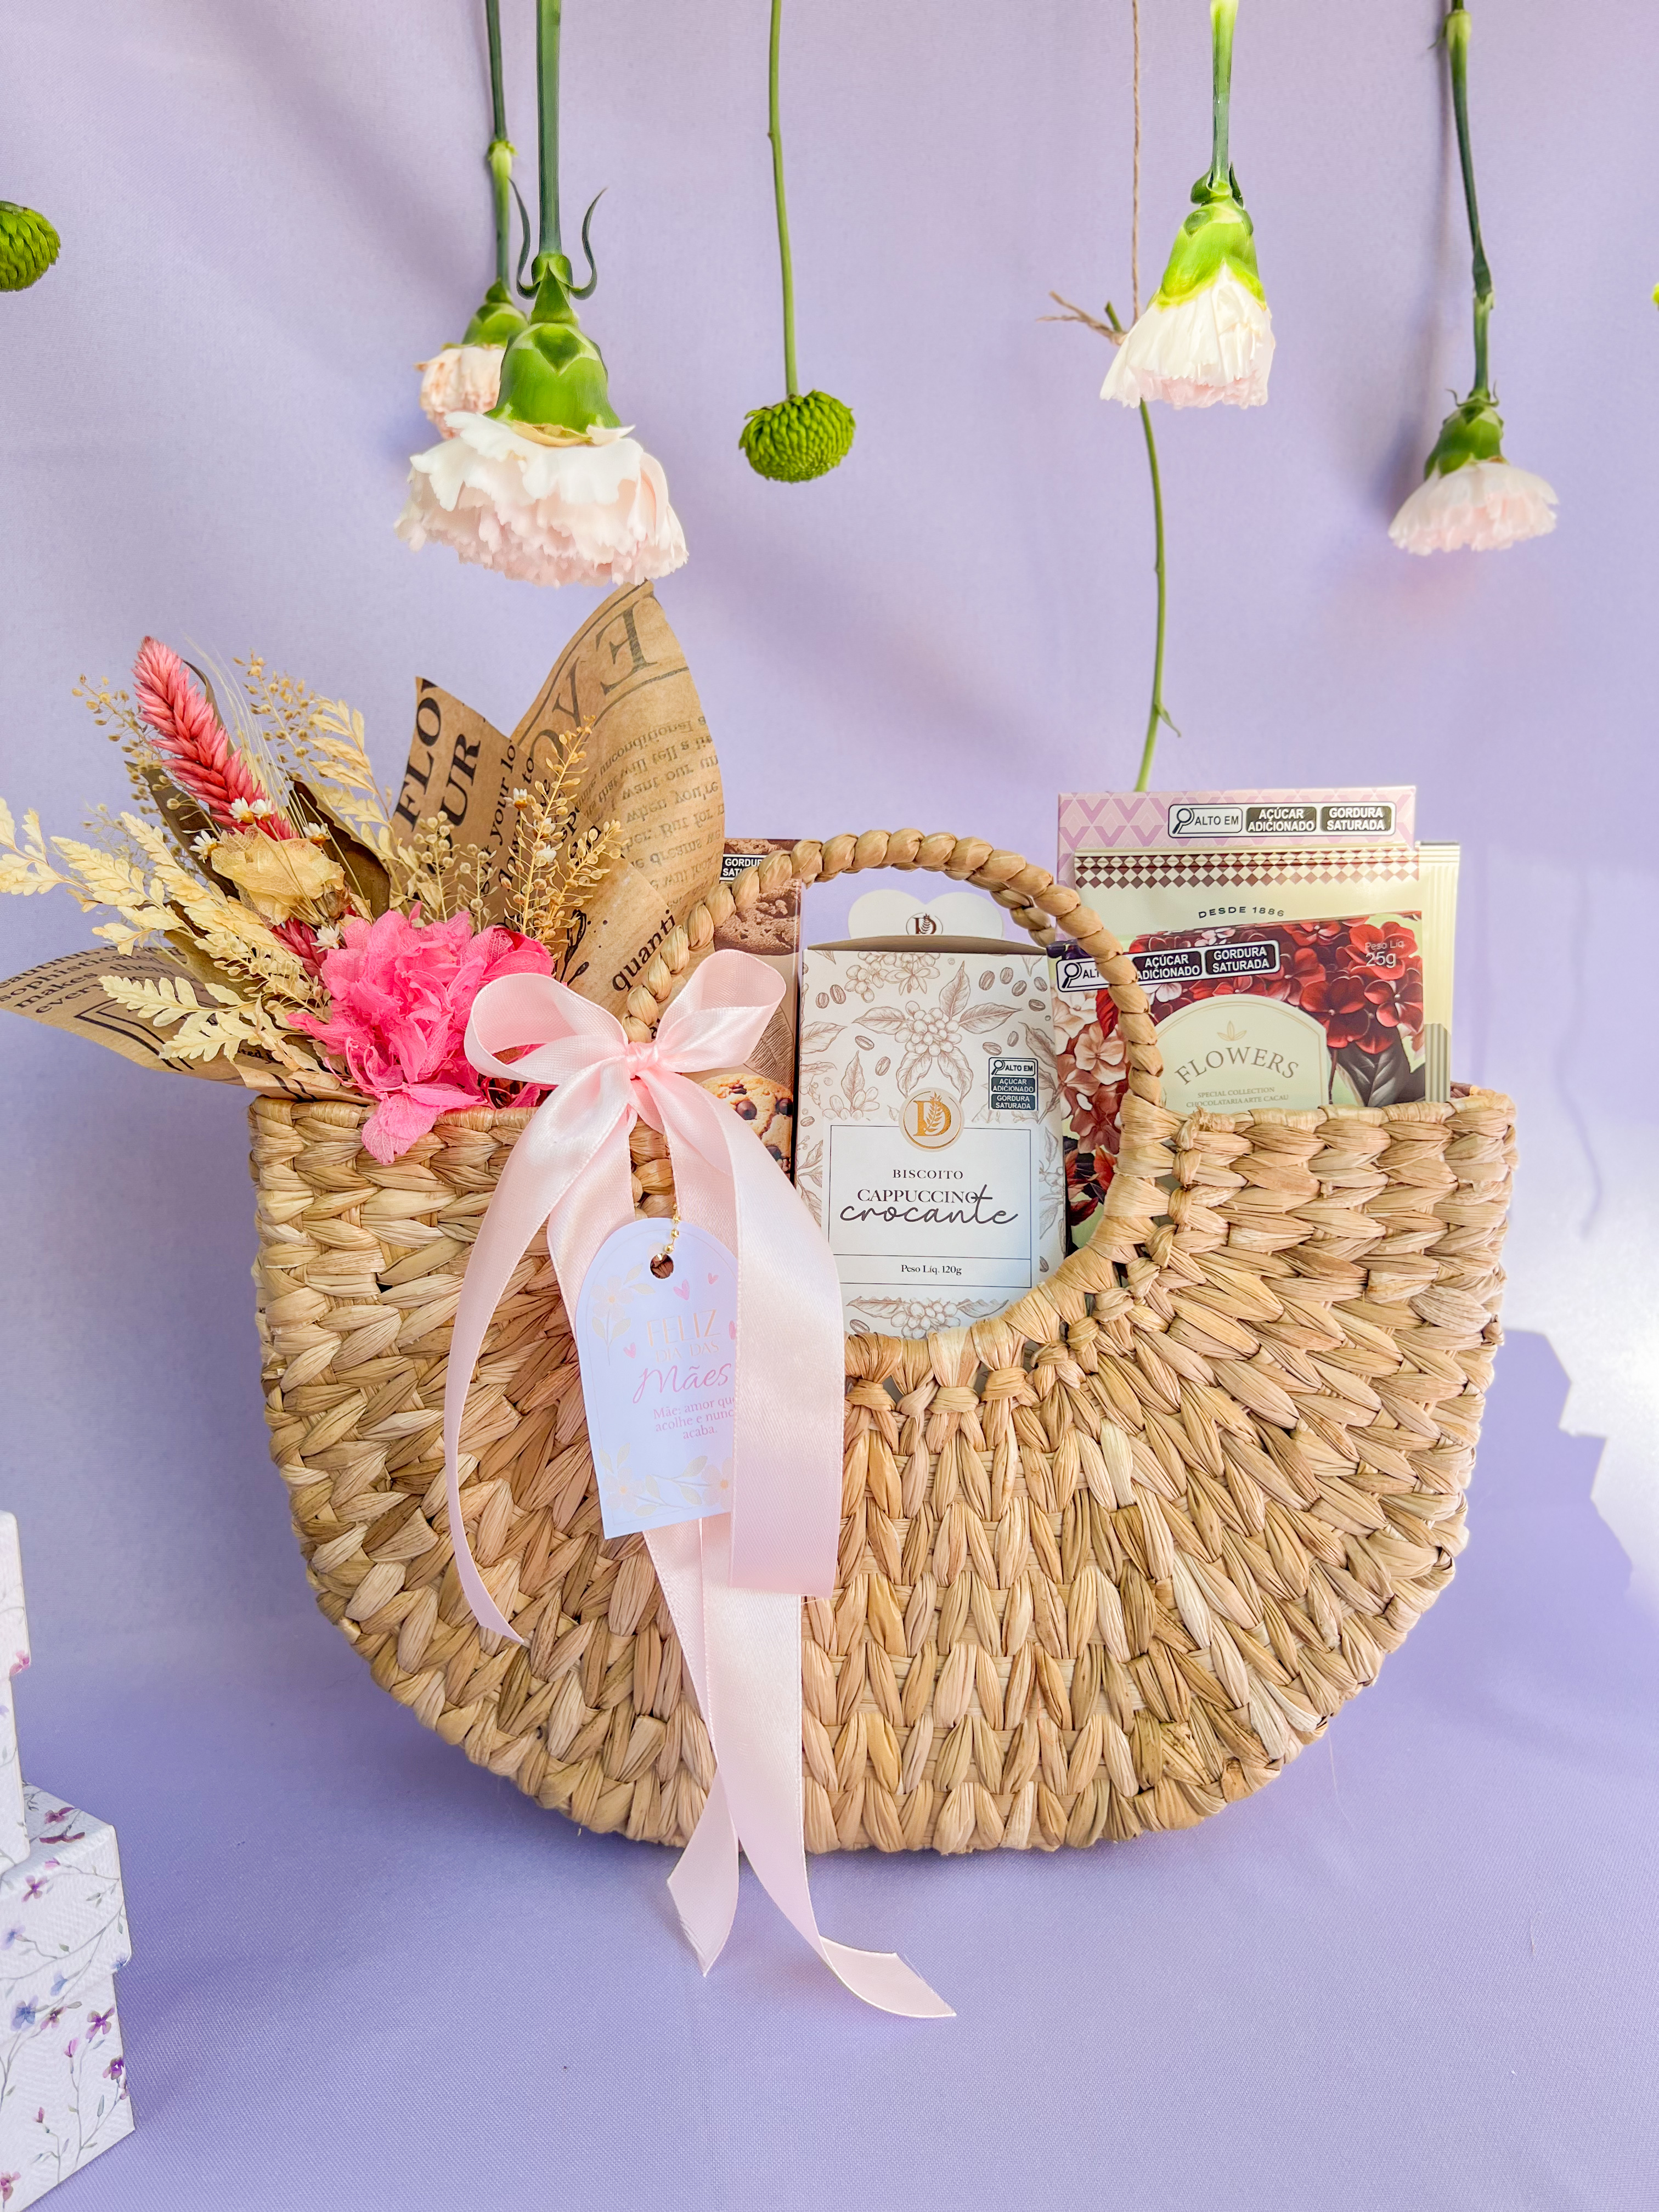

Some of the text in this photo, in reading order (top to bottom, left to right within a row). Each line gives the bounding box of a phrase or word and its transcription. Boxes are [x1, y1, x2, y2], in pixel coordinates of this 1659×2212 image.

[490, 777, 509, 846] your
[1259, 807, 1304, 821] AÇÚCAR
[1329, 807, 1384, 819] GORDURA
[1194, 815, 1239, 826] ALTO EM
[1247, 820, 1315, 832] ADICIONADO
[1327, 819, 1385, 831] SATURADA
[1199, 906, 1284, 919] DESDE 1886
[1214, 946, 1267, 961] GORDURA
[1365, 951, 1396, 968] 25g
[1144, 954, 1189, 971] AÇÚCAR
[1212, 958, 1269, 973] SATURADA
[1082, 968, 1099, 979] ALT
[14, 972, 99, 1008] makes
[1174, 1047, 1299, 1085] FLOWERS
[1198, 1087, 1275, 1098] SPECIAL COLLECTION
[893, 1169, 963, 1180] BISCOITO
[840, 1184, 1018, 1224] crocante
[901, 1265, 921, 1273] Peso
[942, 1265, 962, 1276] 120g
[647, 1309, 721, 1347] FELIZ
[656, 1340, 720, 1363] DIA DAS
[633, 1363, 732, 1404] Mães
[684, 1400, 715, 1413] amor
[656, 1409, 735, 1432] acolhe e nunc
[682, 1424, 718, 1439] acaba.
